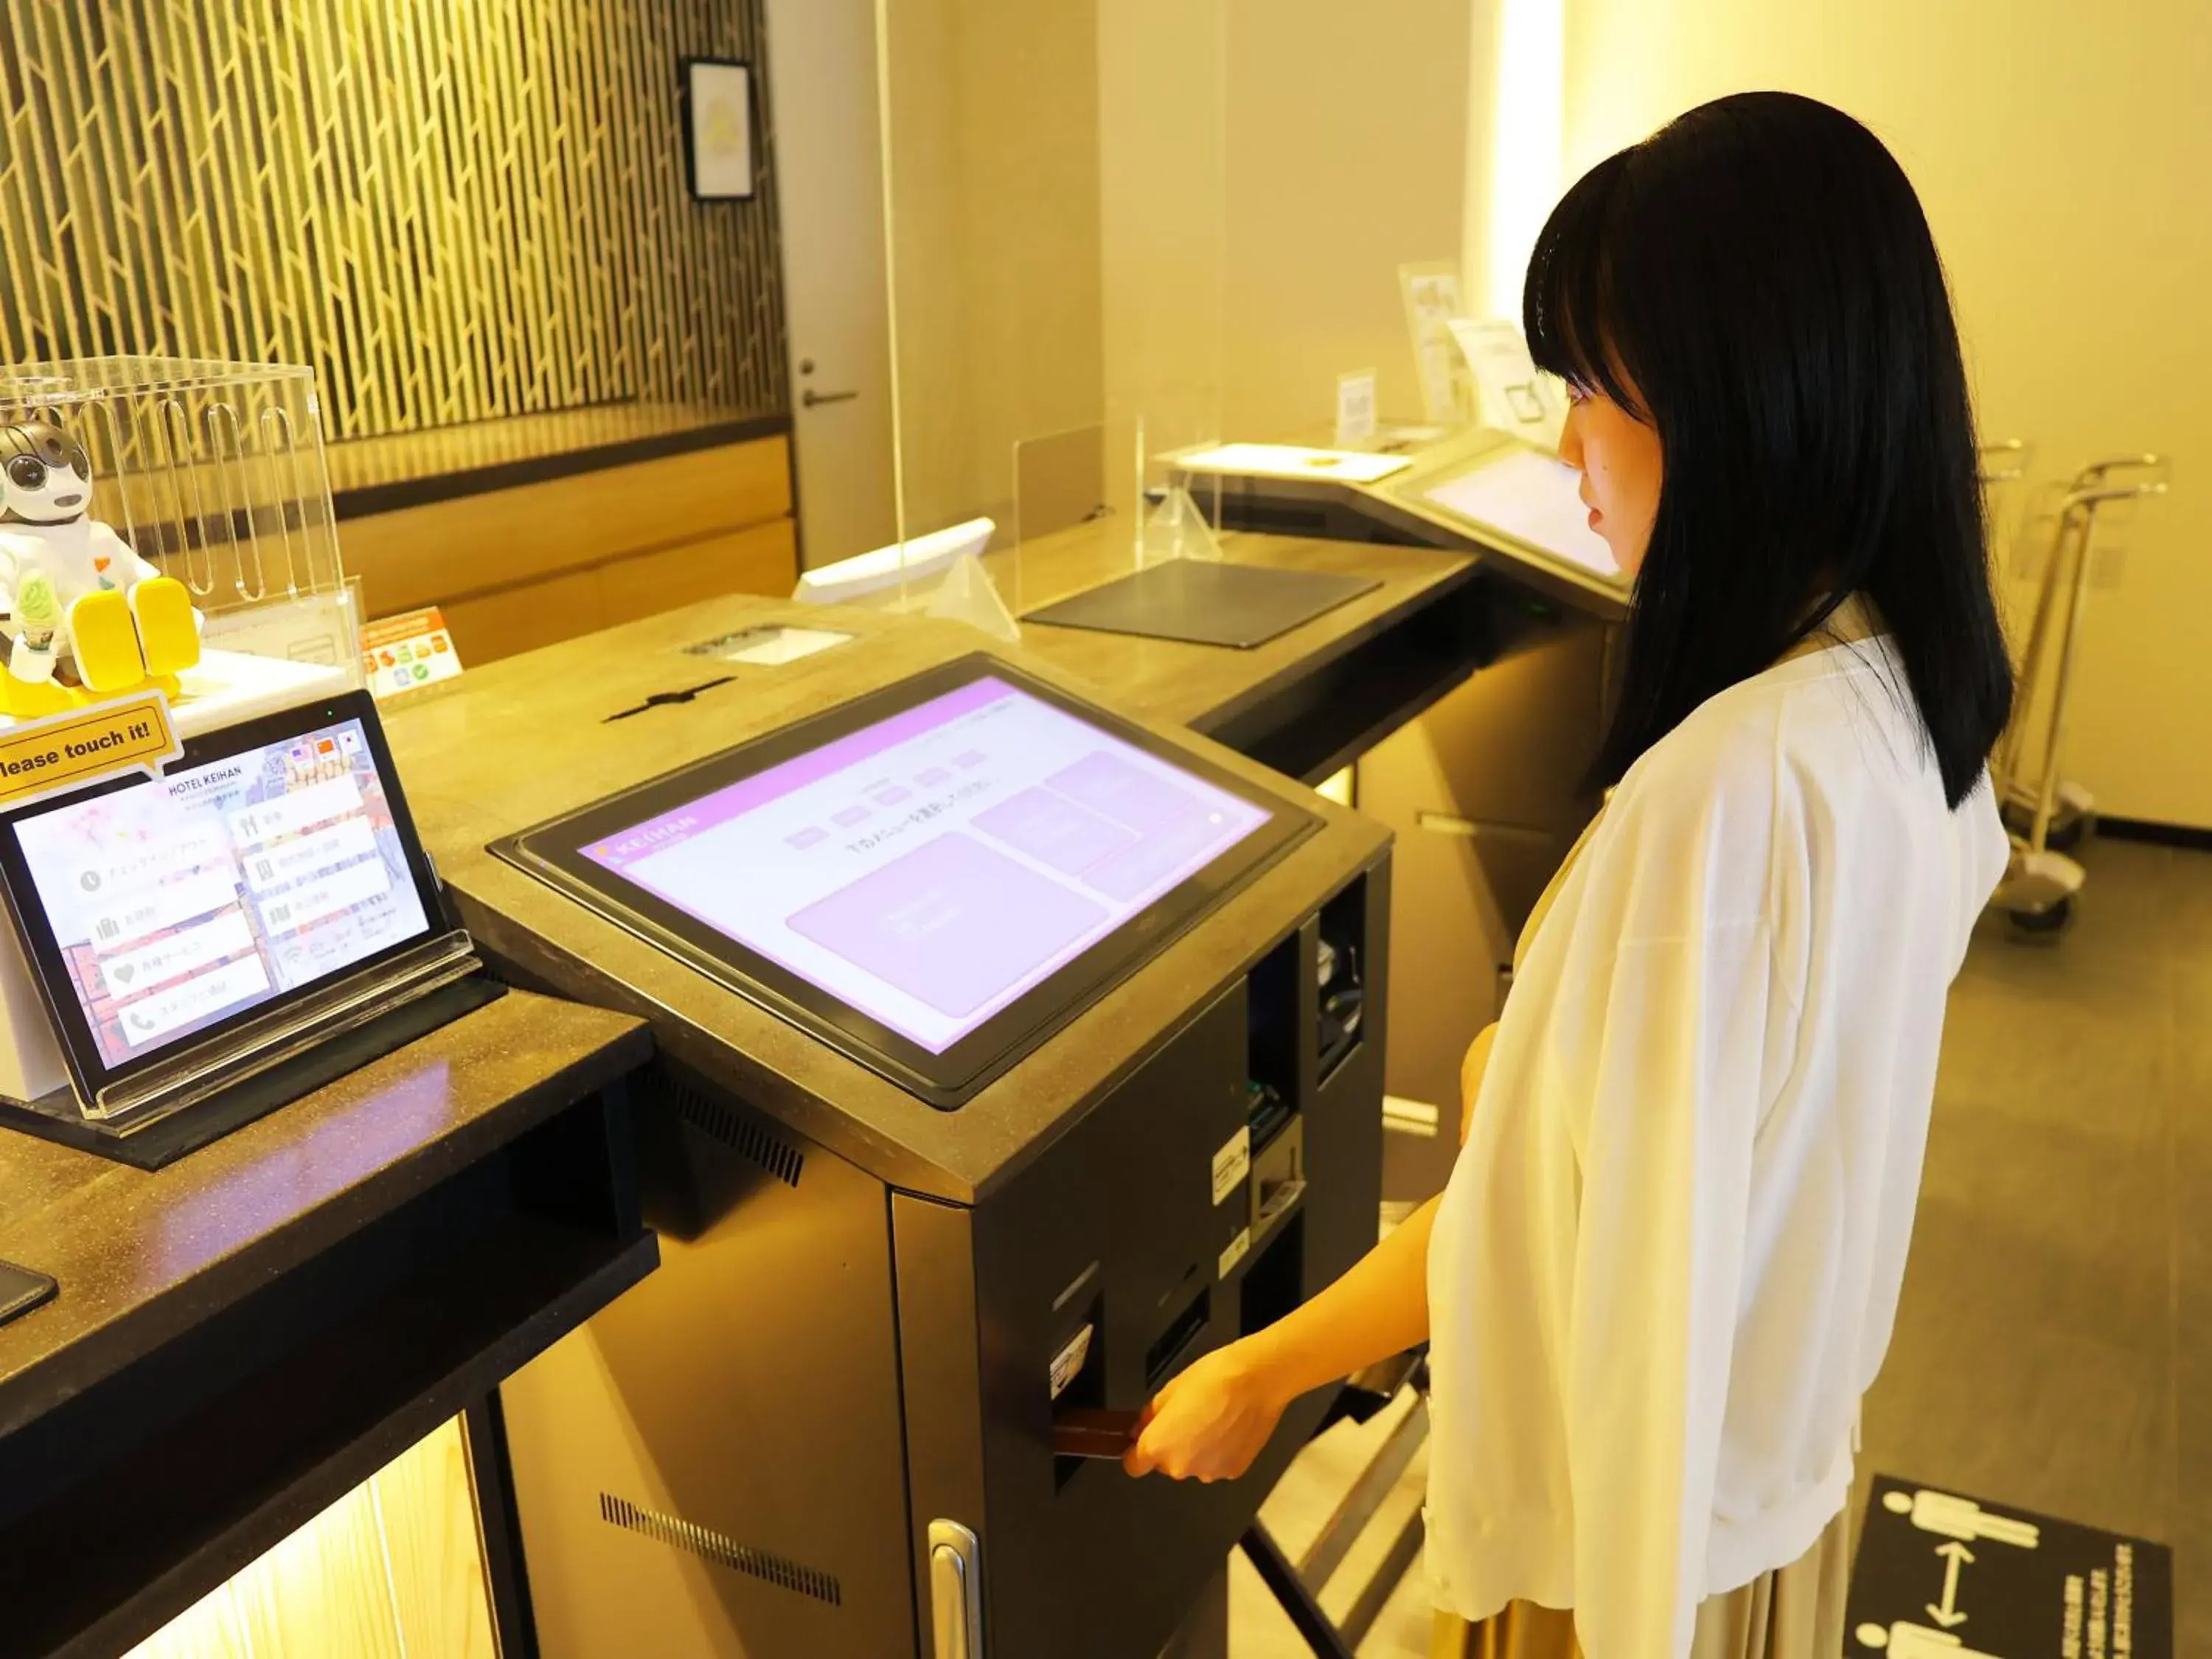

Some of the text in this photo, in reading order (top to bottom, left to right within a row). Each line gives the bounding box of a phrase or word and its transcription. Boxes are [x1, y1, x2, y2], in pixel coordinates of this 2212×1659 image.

[0, 722, 150, 777] lease touch it!
[168, 778, 203, 796] HOTEL
[204, 766, 242, 785] KEIHAN
